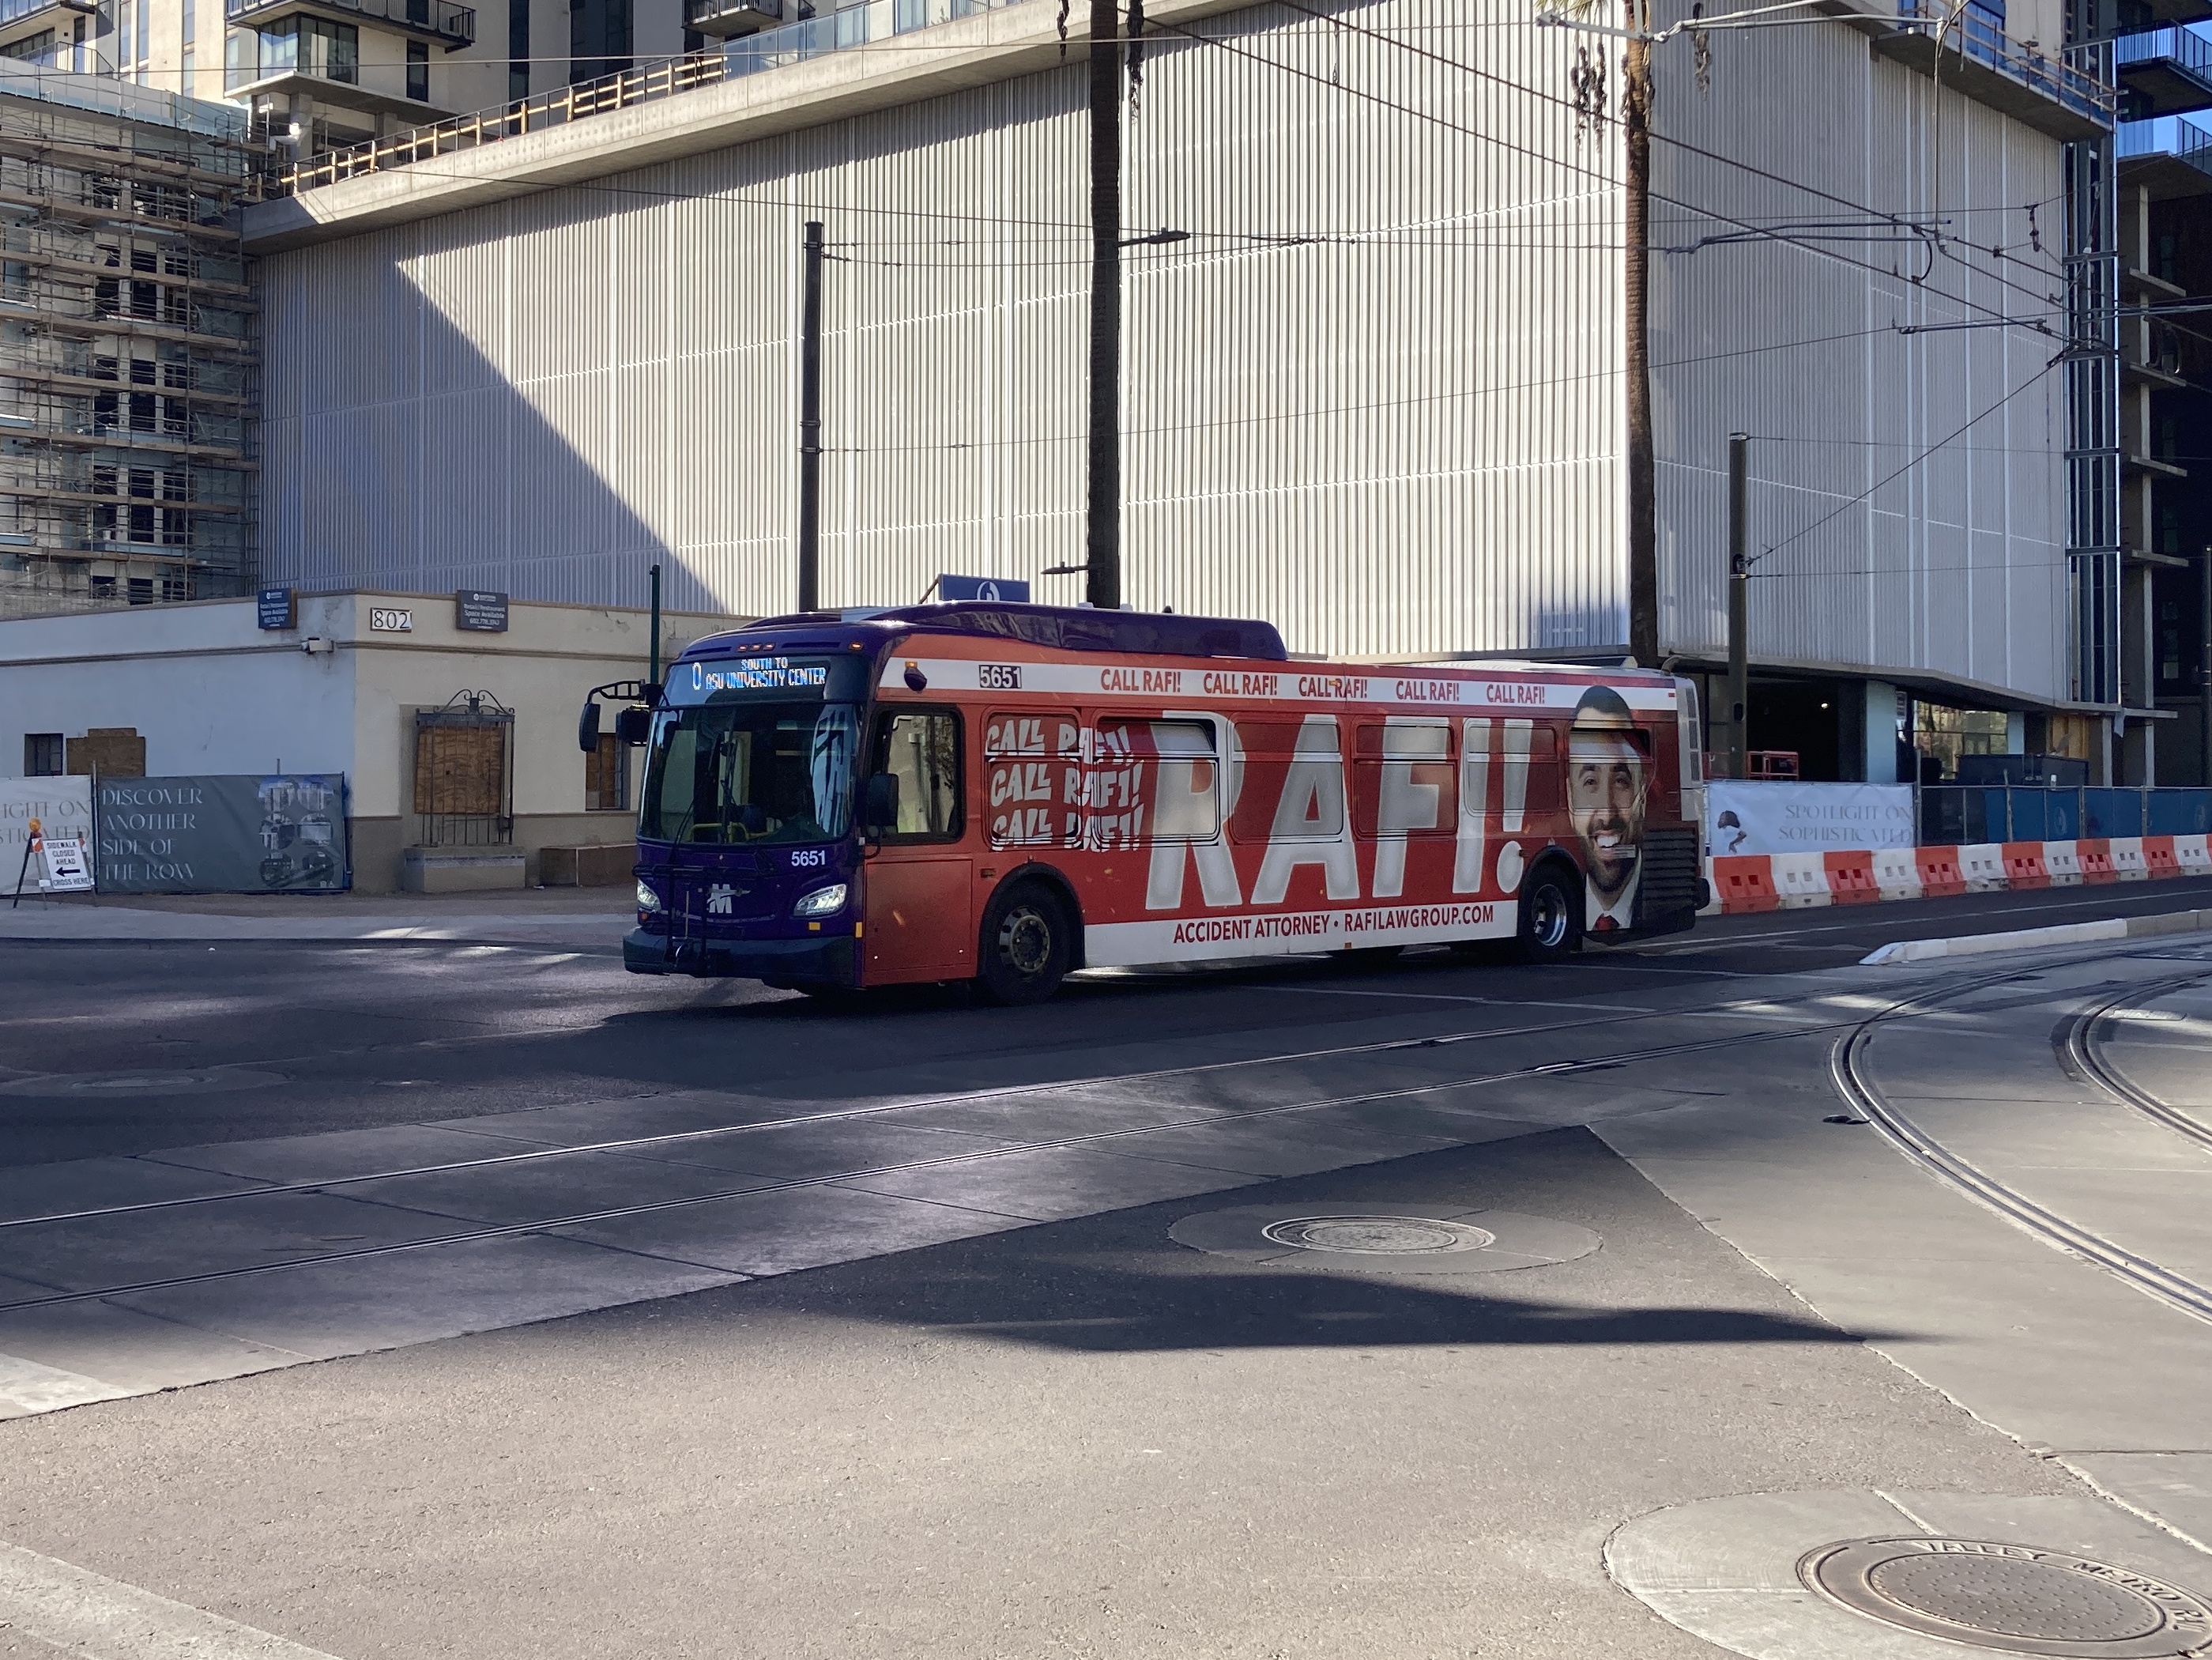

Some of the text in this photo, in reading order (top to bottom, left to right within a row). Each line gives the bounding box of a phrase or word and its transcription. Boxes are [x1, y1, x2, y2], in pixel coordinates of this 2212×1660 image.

[374, 610, 410, 629] 802
[741, 657, 789, 671] SOUTH TO
[705, 667, 827, 690] ASU UNIVERSITY CENTER
[980, 666, 1021, 688] 5651
[1101, 669, 1181, 693] CALL RAFI!
[1204, 673, 1278, 696] CALL RAFI!
[1298, 677, 1368, 699] CALL RAFI!
[1396, 680, 1460, 702] CALL RAFI!
[1487, 684, 1545, 704] CALL RAFI!
[985, 719, 1046, 756] CALL
[990, 759, 1144, 808] CALL RAFI!
[102, 788, 203, 805] DISCOVER
[1, 801, 48, 819] IGHT
[1145, 711, 1533, 911] RAFI!
[1784, 804, 1913, 821] SPOTLIGHT ON
[103, 813, 197, 831] ANOTHER
[992, 809, 1053, 851] CALL
[1778, 825, 1913, 843] SOPHISTICATED
[47, 841, 77, 850] SIDEWALK
[101, 838, 178, 855] SIDE OF
[791, 850, 826, 867] 5651
[101, 862, 198, 881] THE ROW
[1173, 904, 1494, 945] ACCIDENT ATTORNEY RAFILAWGROUP.COM
[1909, 1540, 2048, 1561] VALLEY
[2072, 1562, 2183, 1601] METRO
